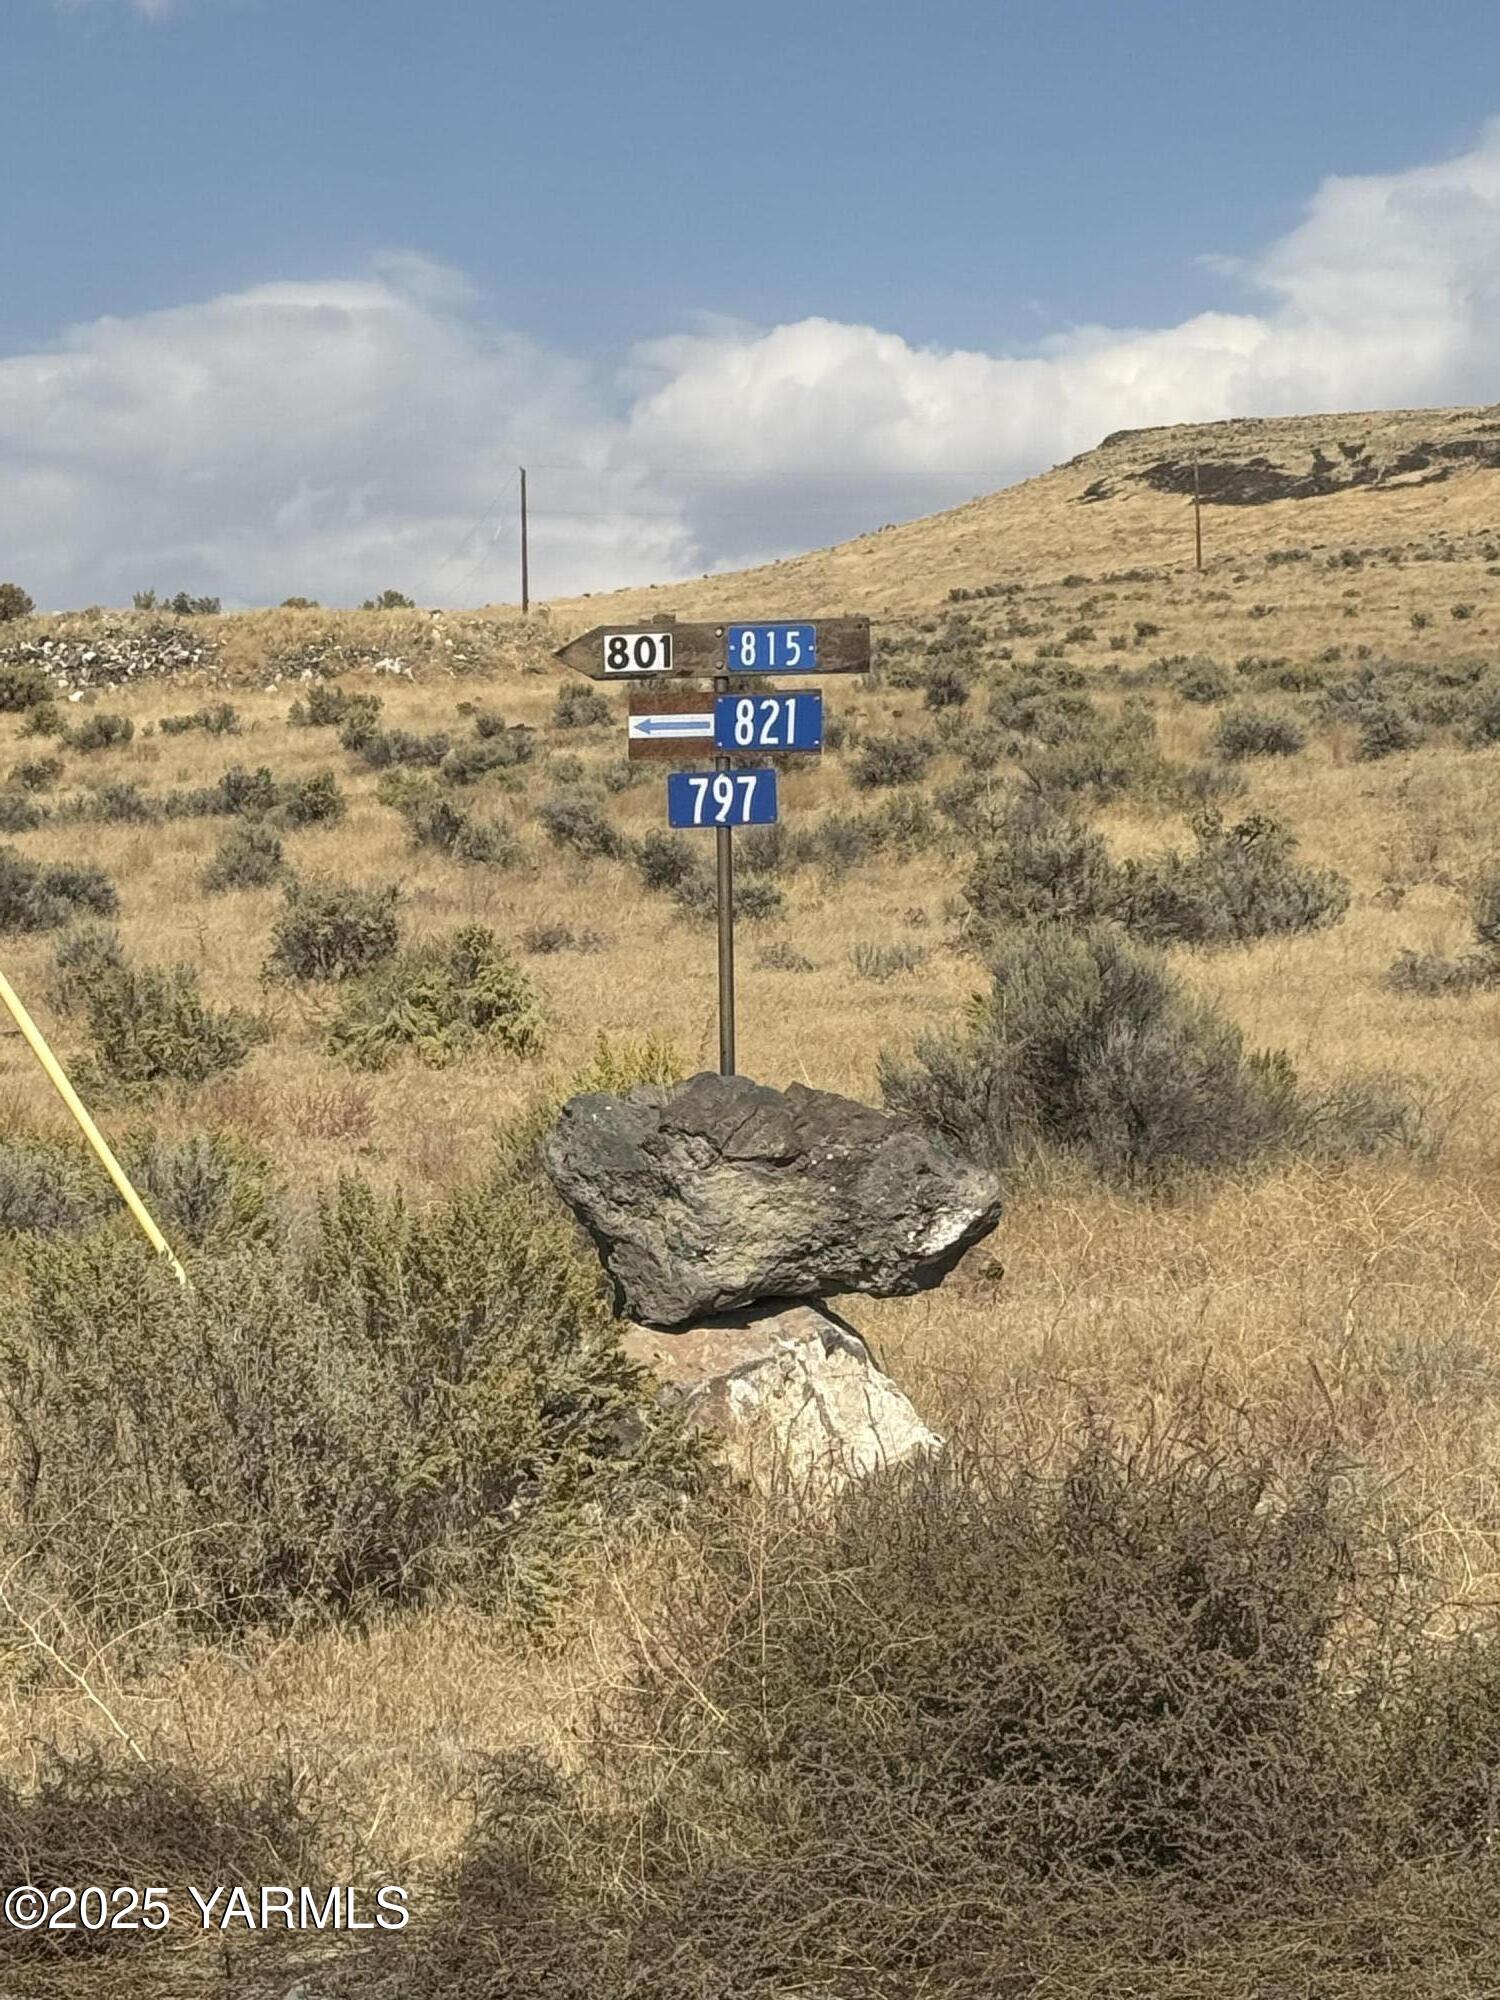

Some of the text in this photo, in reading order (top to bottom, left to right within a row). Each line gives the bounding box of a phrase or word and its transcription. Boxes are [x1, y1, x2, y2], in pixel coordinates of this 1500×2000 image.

[607, 634, 672, 670] 801
[740, 630, 801, 667] 815
[734, 698, 797, 746] 821
[688, 773, 757, 824] 797
